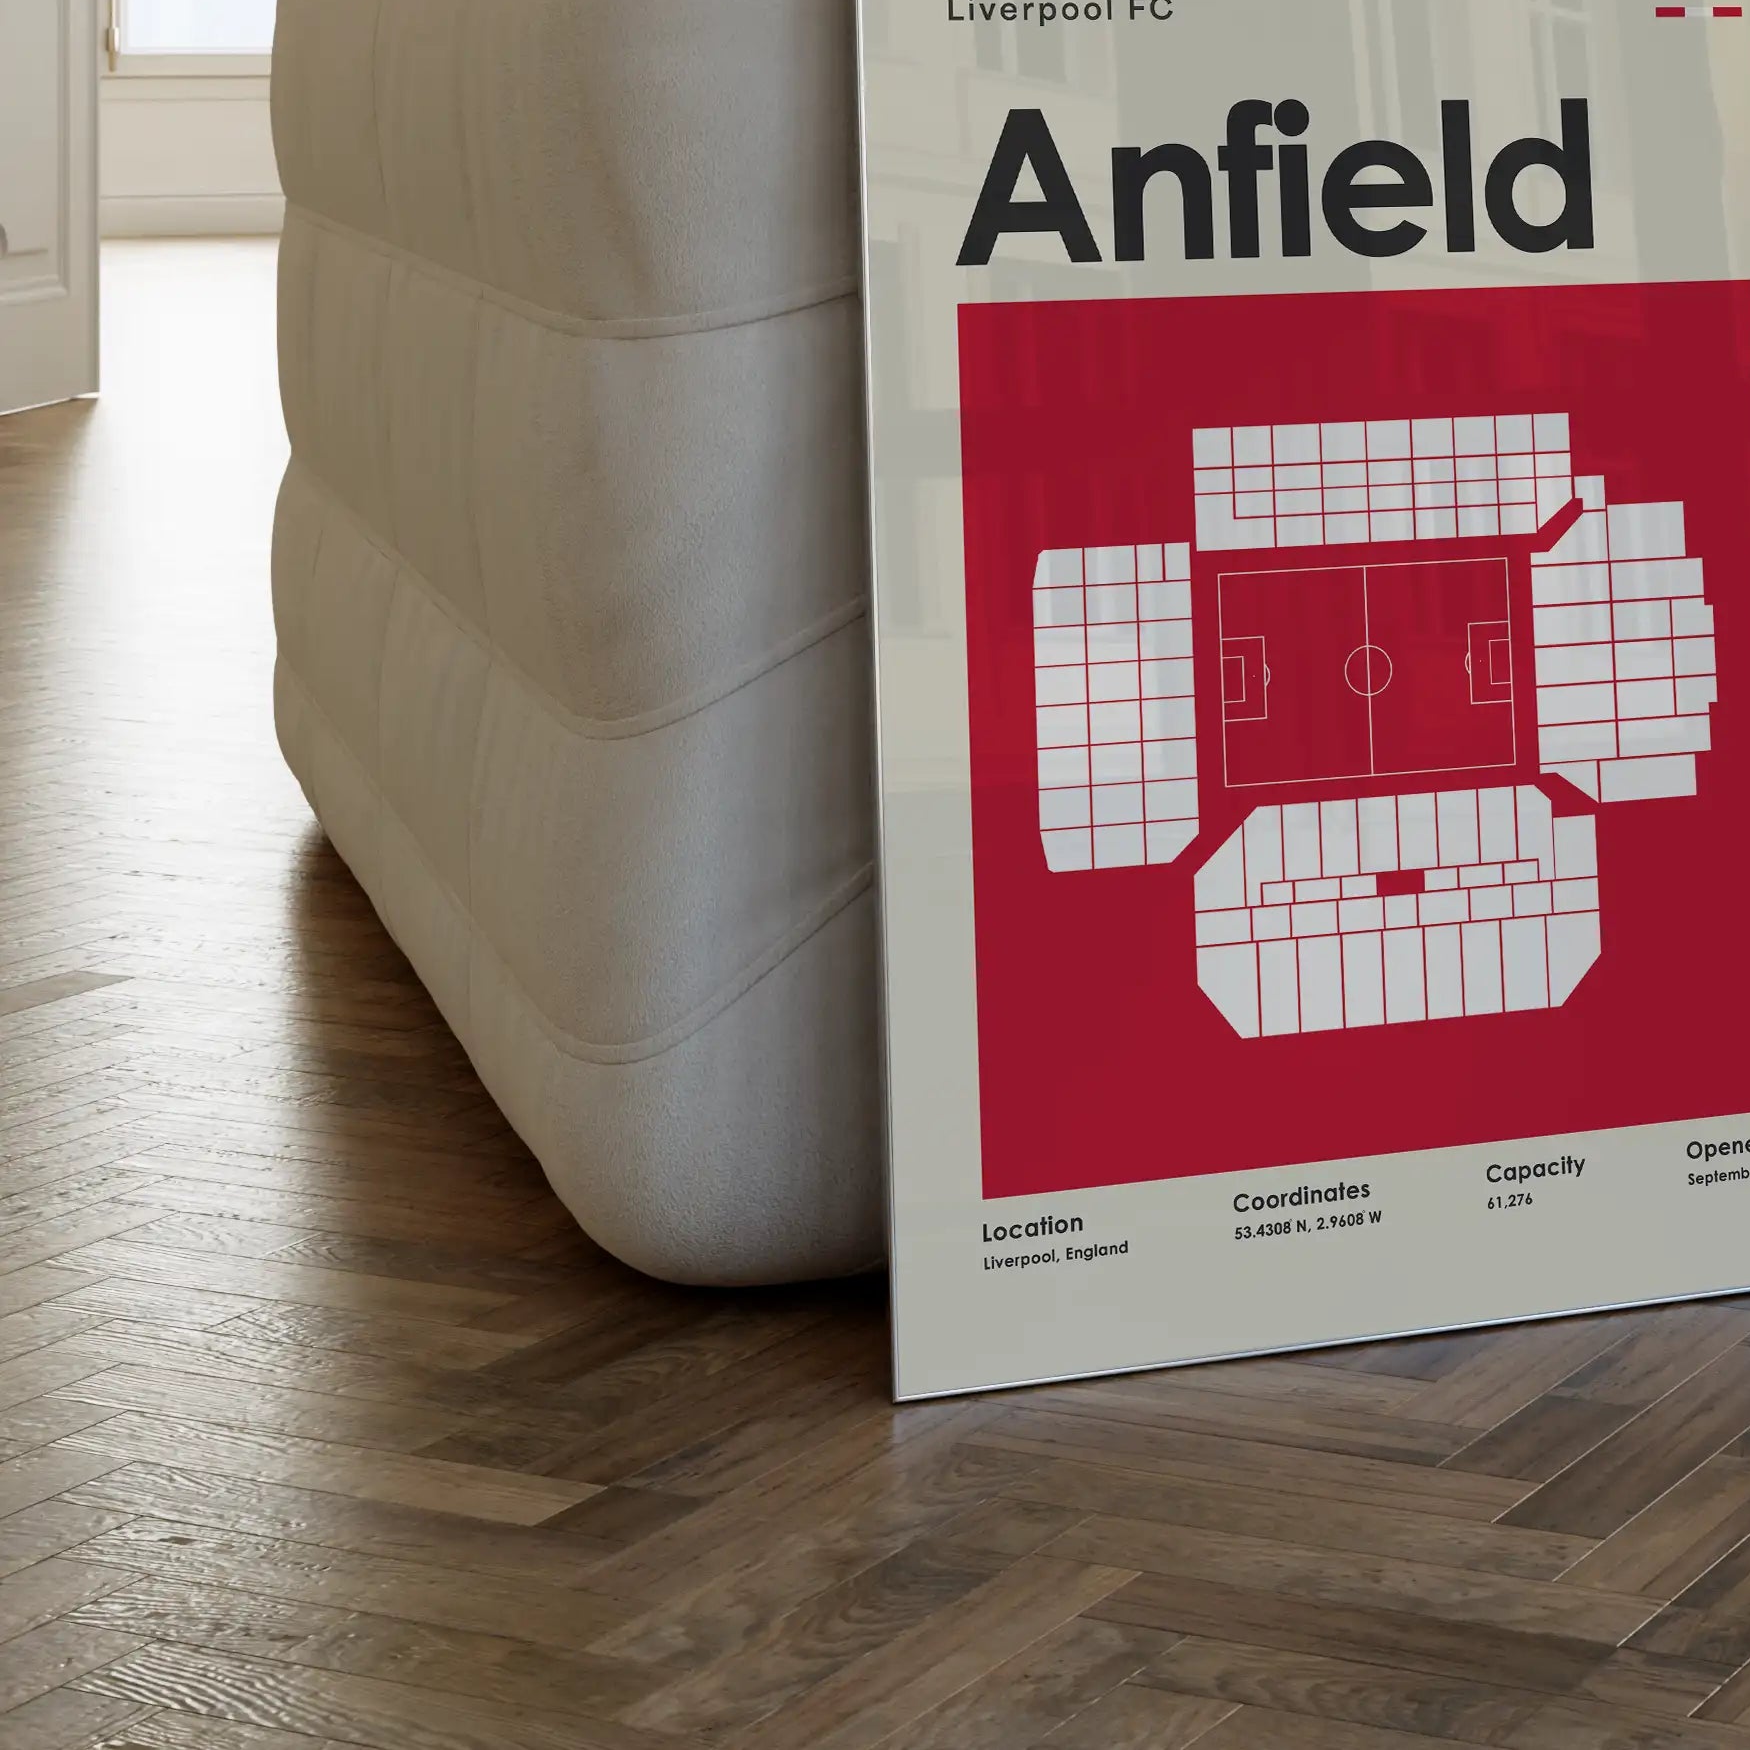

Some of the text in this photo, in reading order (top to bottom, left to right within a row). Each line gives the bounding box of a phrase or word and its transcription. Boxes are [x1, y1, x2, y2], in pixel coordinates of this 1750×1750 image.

[955, 98, 1594, 266] Anfield
[1486, 1155, 1586, 1185] Capacity
[1234, 1182, 1371, 1213] Coordinates
[1487, 1192, 1534, 1210] 61,276
[982, 1215, 1084, 1243] Location
[1296, 1219, 1312, 1234] N,
[1368, 1210, 1382, 1224] W
[983, 1239, 1129, 1271] Liverpool, England
